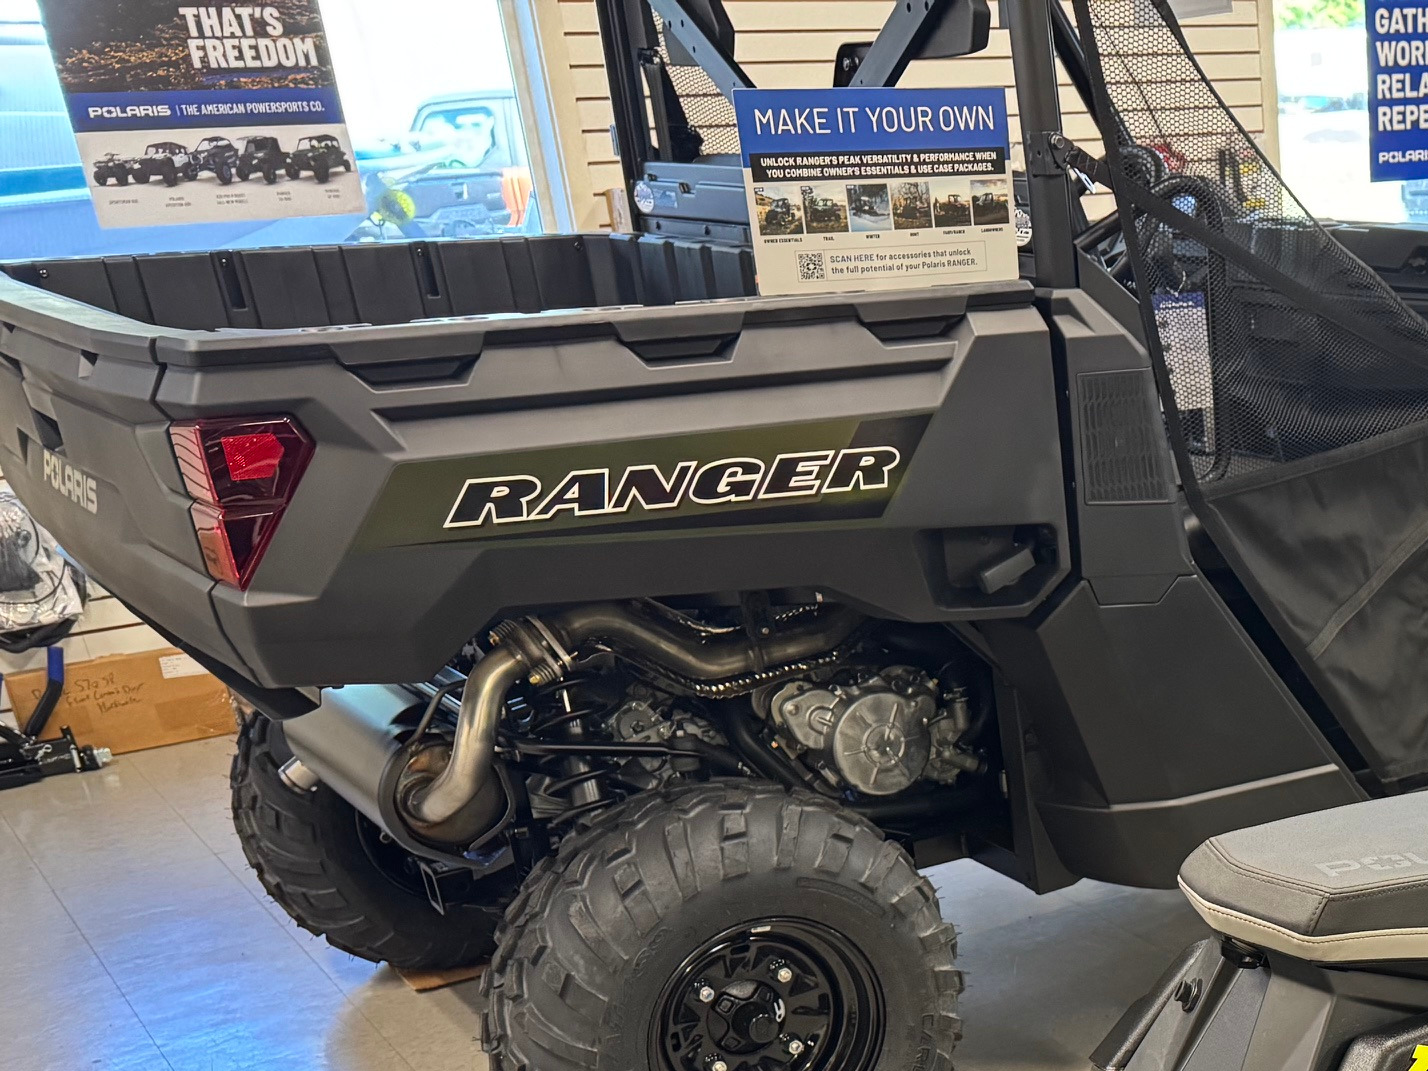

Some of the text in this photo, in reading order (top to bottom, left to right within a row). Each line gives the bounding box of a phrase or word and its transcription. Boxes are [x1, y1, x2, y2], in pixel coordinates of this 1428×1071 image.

[178, 6, 283, 37] THAT'S
[189, 37, 319, 70] FREEDOM
[88, 104, 172, 118] POLARIS
[181, 101, 325, 116] THE AMERICAN POWERSPORTS CO.
[753, 105, 995, 135] MAKE IT YOUR OWN
[760, 151, 997, 167] UNLOCK RANGER'S PEAK VERSATILITY & PERFORMANCE WHEN
[766, 162, 994, 179] YOU COMBINE OWNER'S ESSENTIALS & USE CASE PACKAGES.
[830, 247, 971, 263] SCAN HERE for accessories that unlock
[831, 258, 978, 275] the full potential of your Polaris RANGER.
[42, 453, 98, 515] POLARIS
[443, 445, 900, 528] RANGER
